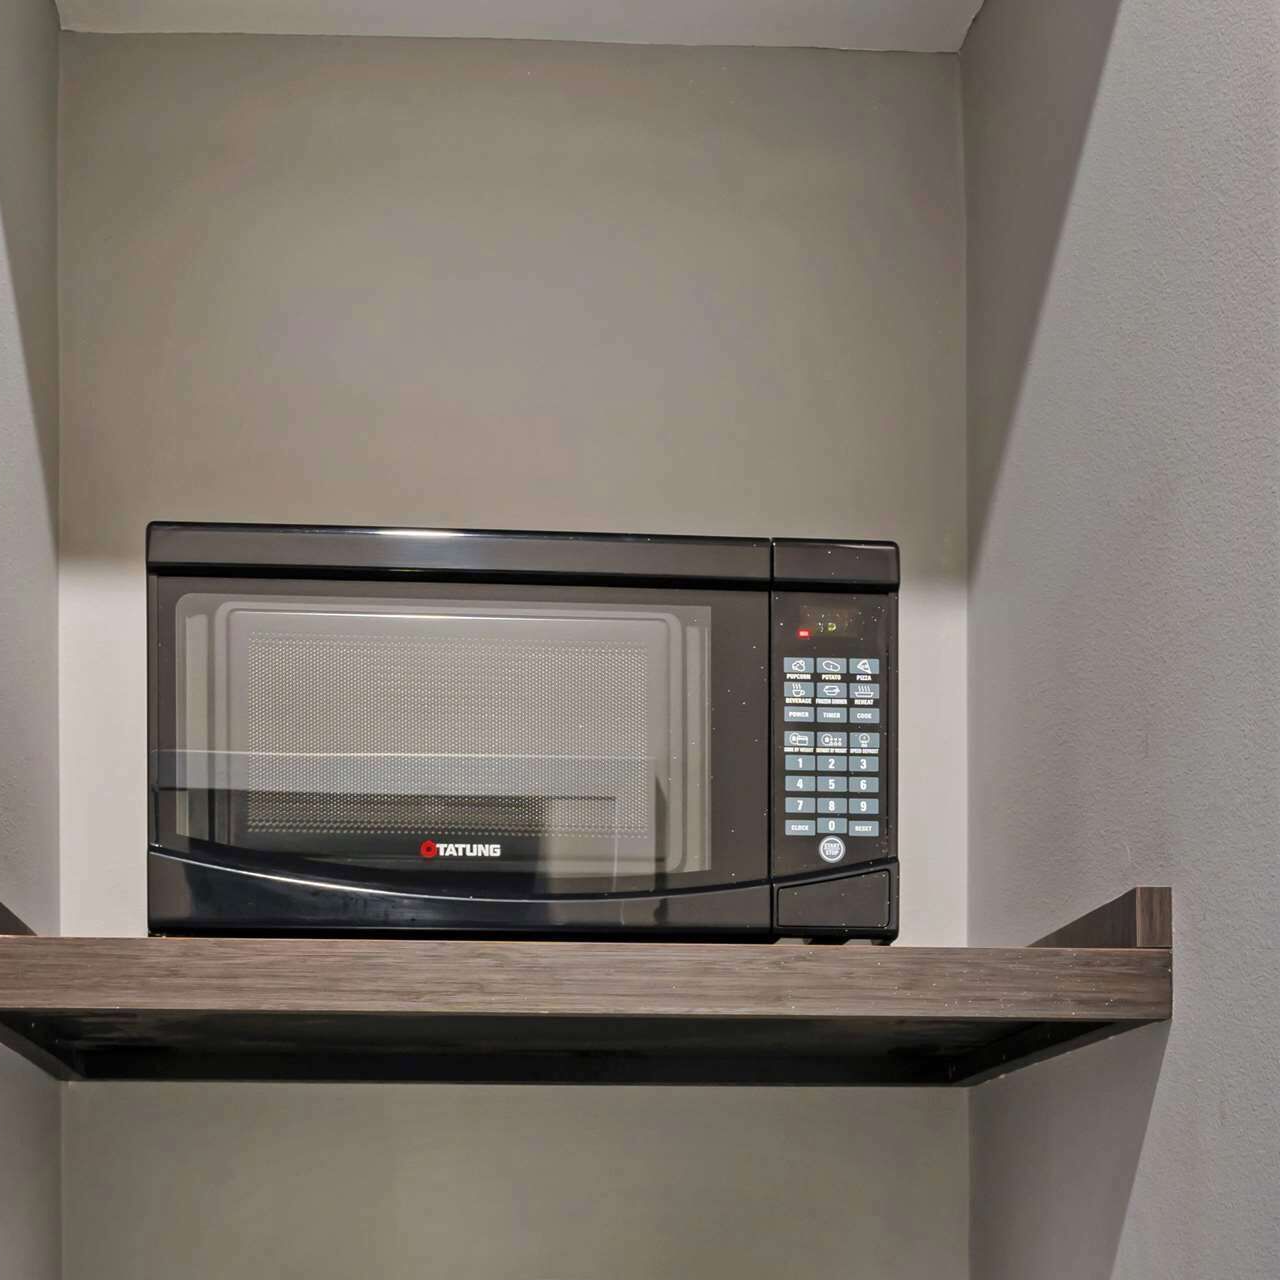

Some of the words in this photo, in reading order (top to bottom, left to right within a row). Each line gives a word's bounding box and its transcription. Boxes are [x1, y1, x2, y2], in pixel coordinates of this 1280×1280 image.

[798, 758, 802, 768] 1
[829, 759, 835, 768] 2
[860, 759, 866, 769] 3
[797, 779, 803, 789] 4
[829, 780, 835, 789] 5
[860, 780, 867, 790] 6
[797, 800, 803, 810] 7
[829, 801, 835, 811] 8
[860, 801, 867, 811] 9
[828, 821, 835, 831] 0
[436, 844, 501, 857] TATUNG
